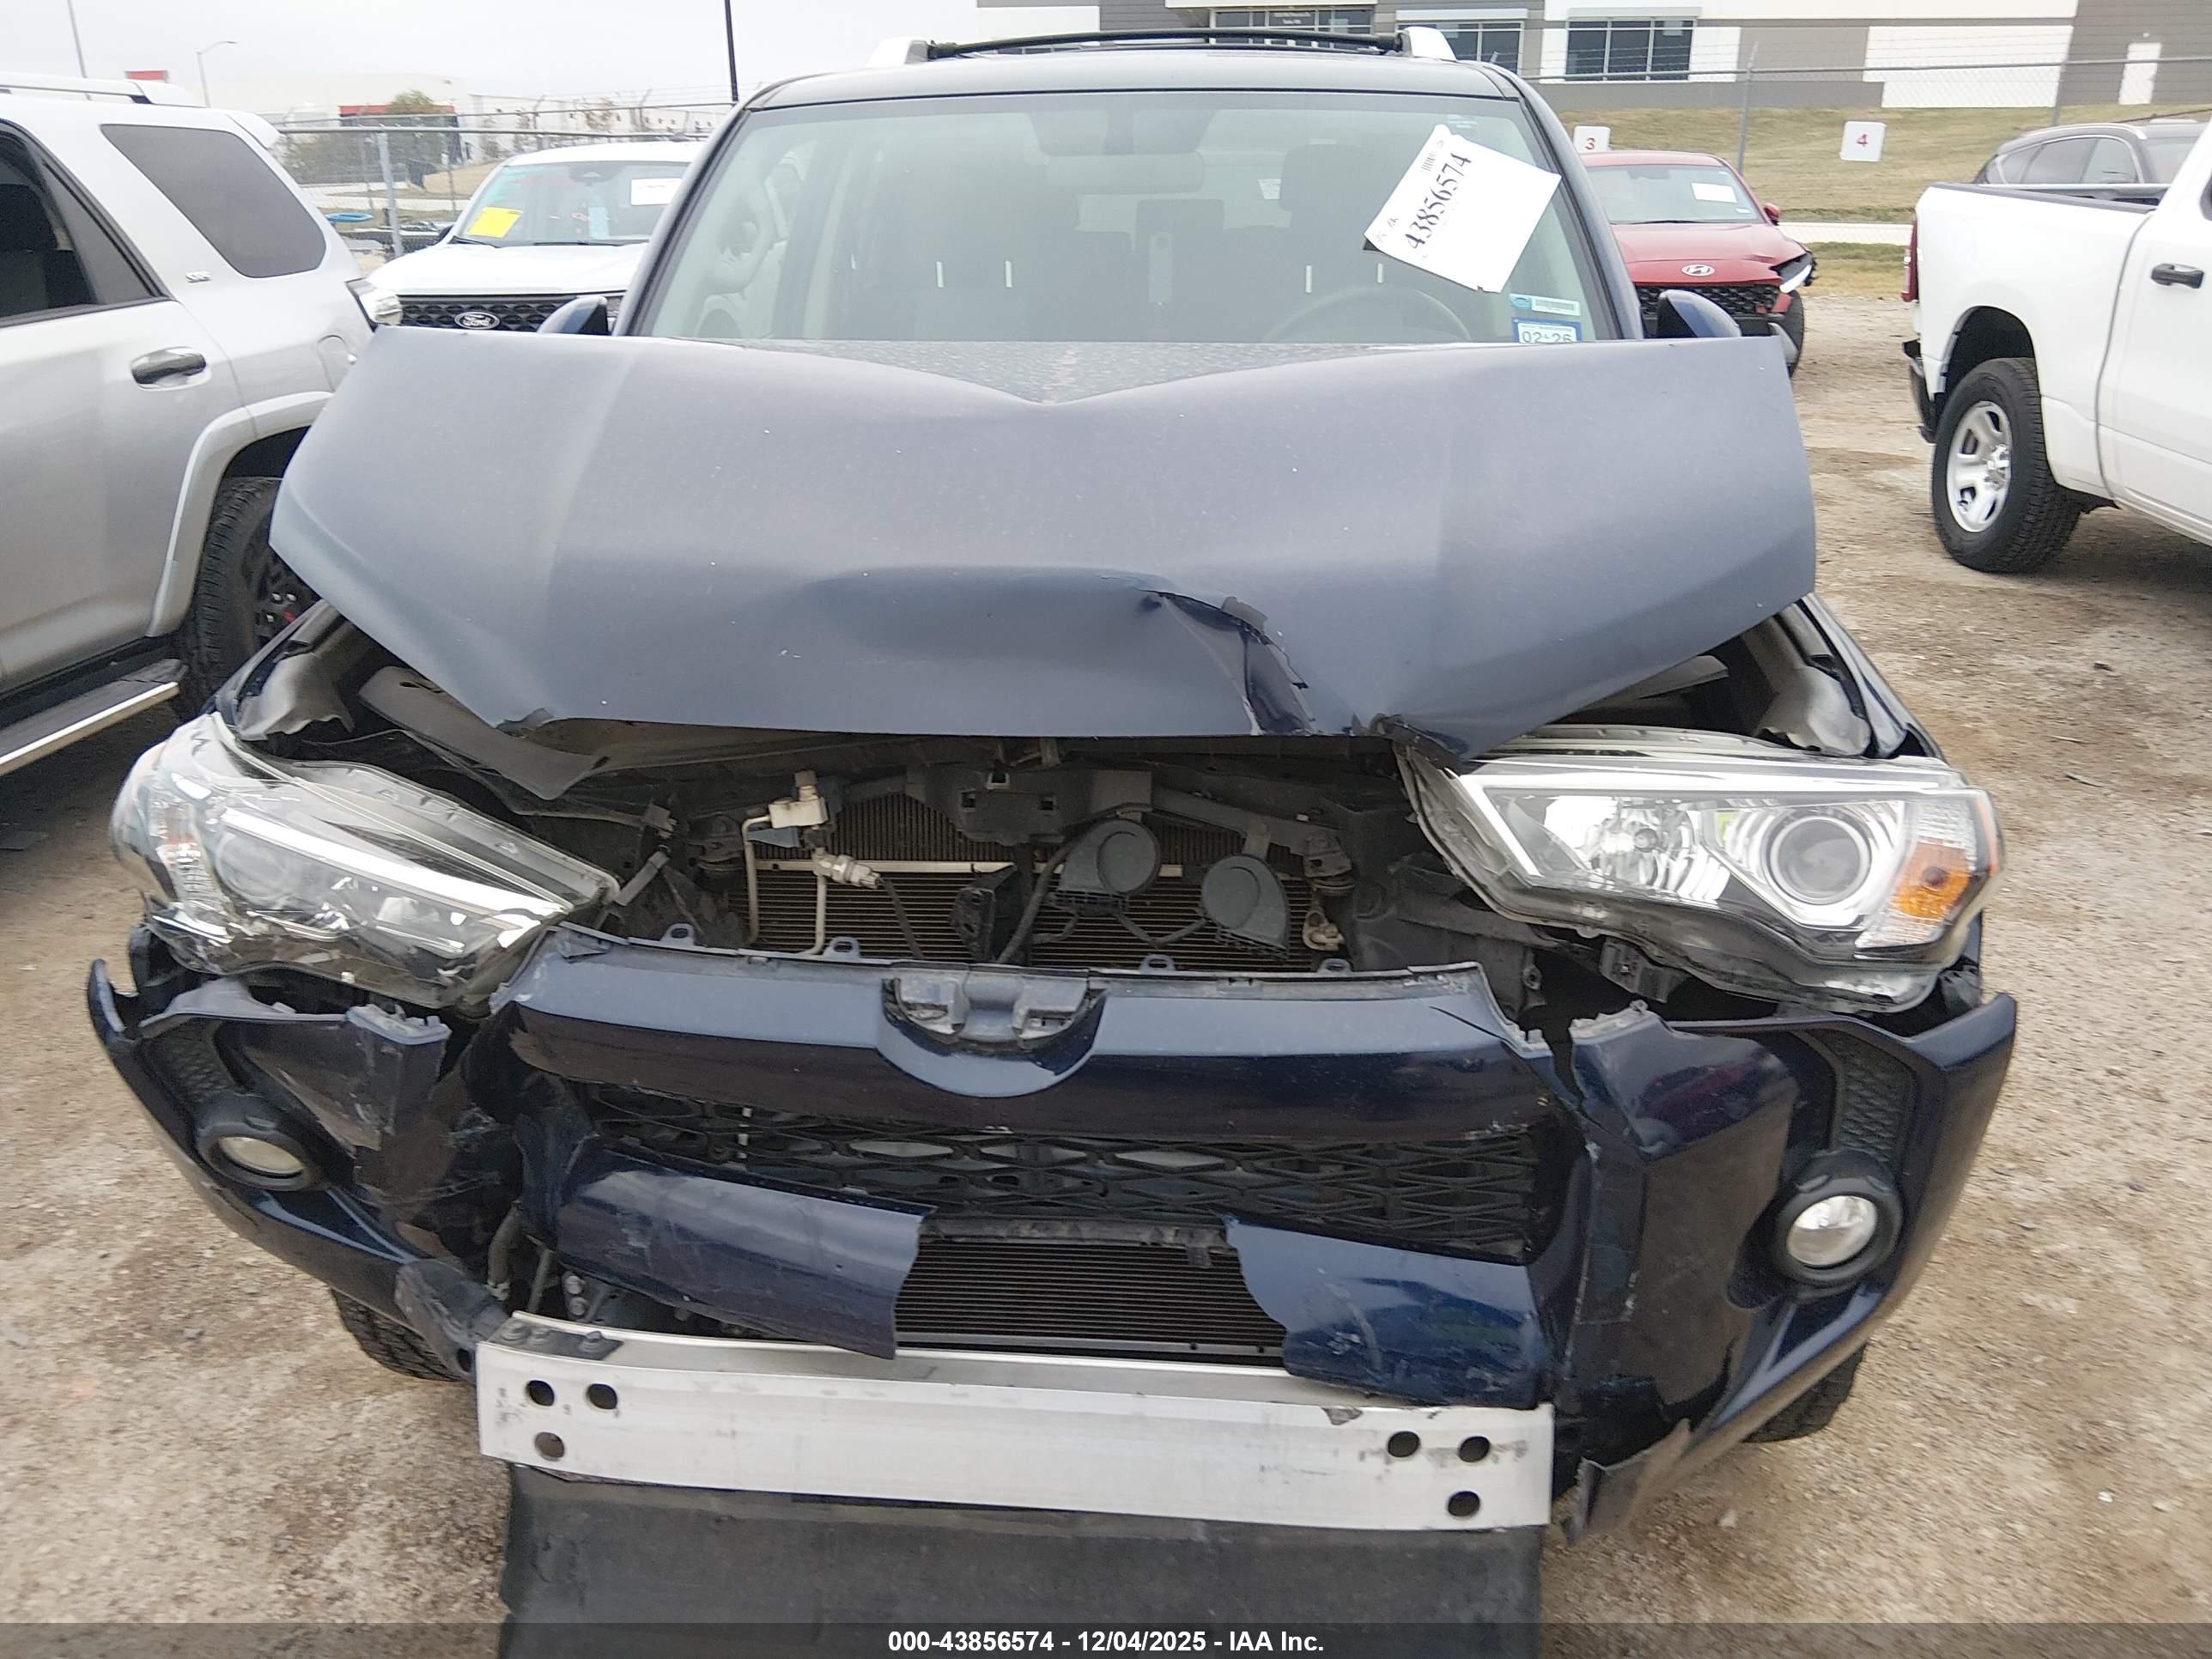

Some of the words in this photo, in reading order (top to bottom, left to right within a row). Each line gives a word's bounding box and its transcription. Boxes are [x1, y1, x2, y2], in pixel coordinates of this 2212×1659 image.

[1584, 137, 1595, 150] 3
[1856, 133, 1869, 148] 4
[1405, 152, 1472, 249] 43856574
